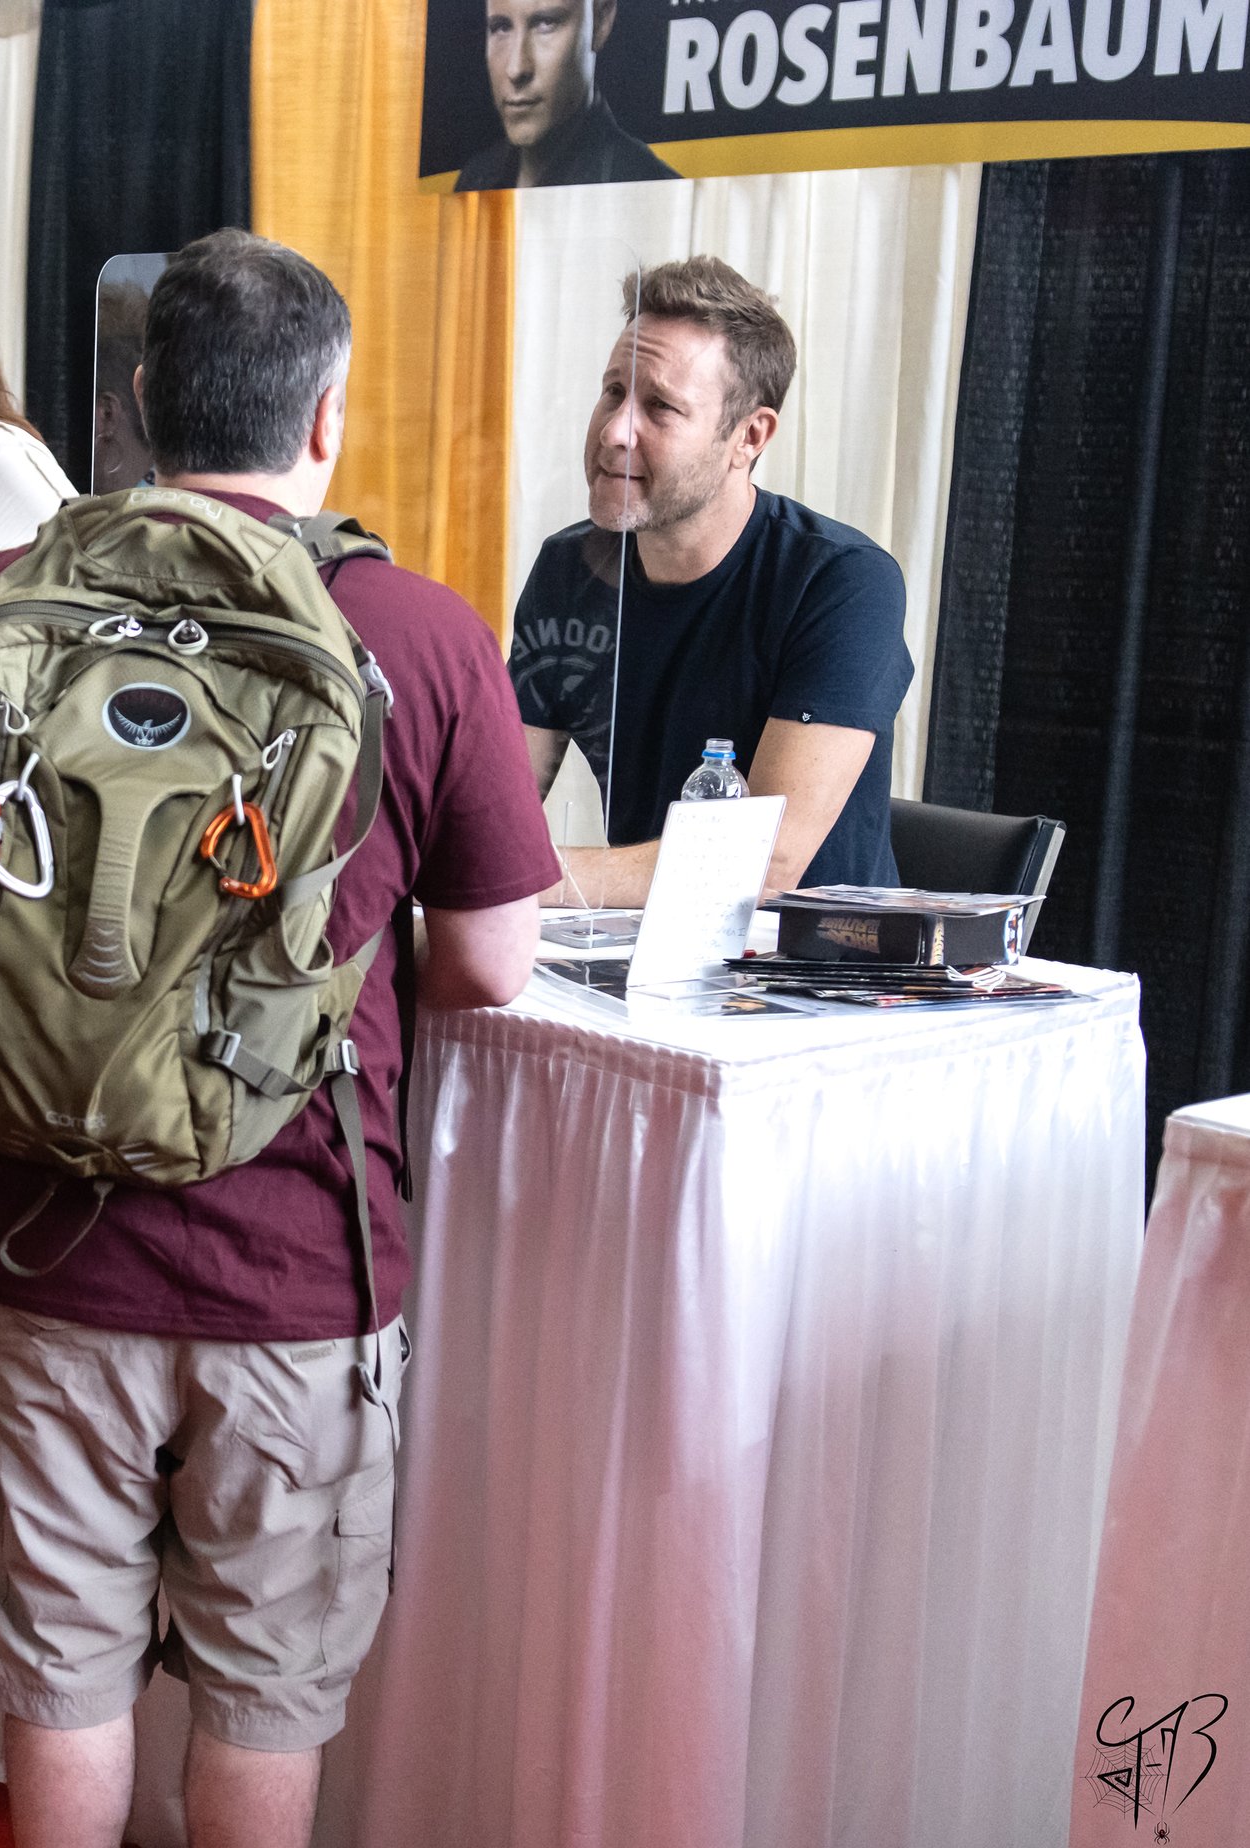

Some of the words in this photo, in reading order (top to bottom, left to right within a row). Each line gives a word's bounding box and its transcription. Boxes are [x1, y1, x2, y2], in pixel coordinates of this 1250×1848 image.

[662, 0, 1250, 115] ROSENBAUM
[130, 490, 223, 520] osprey
[46, 1110, 107, 1129] comt
